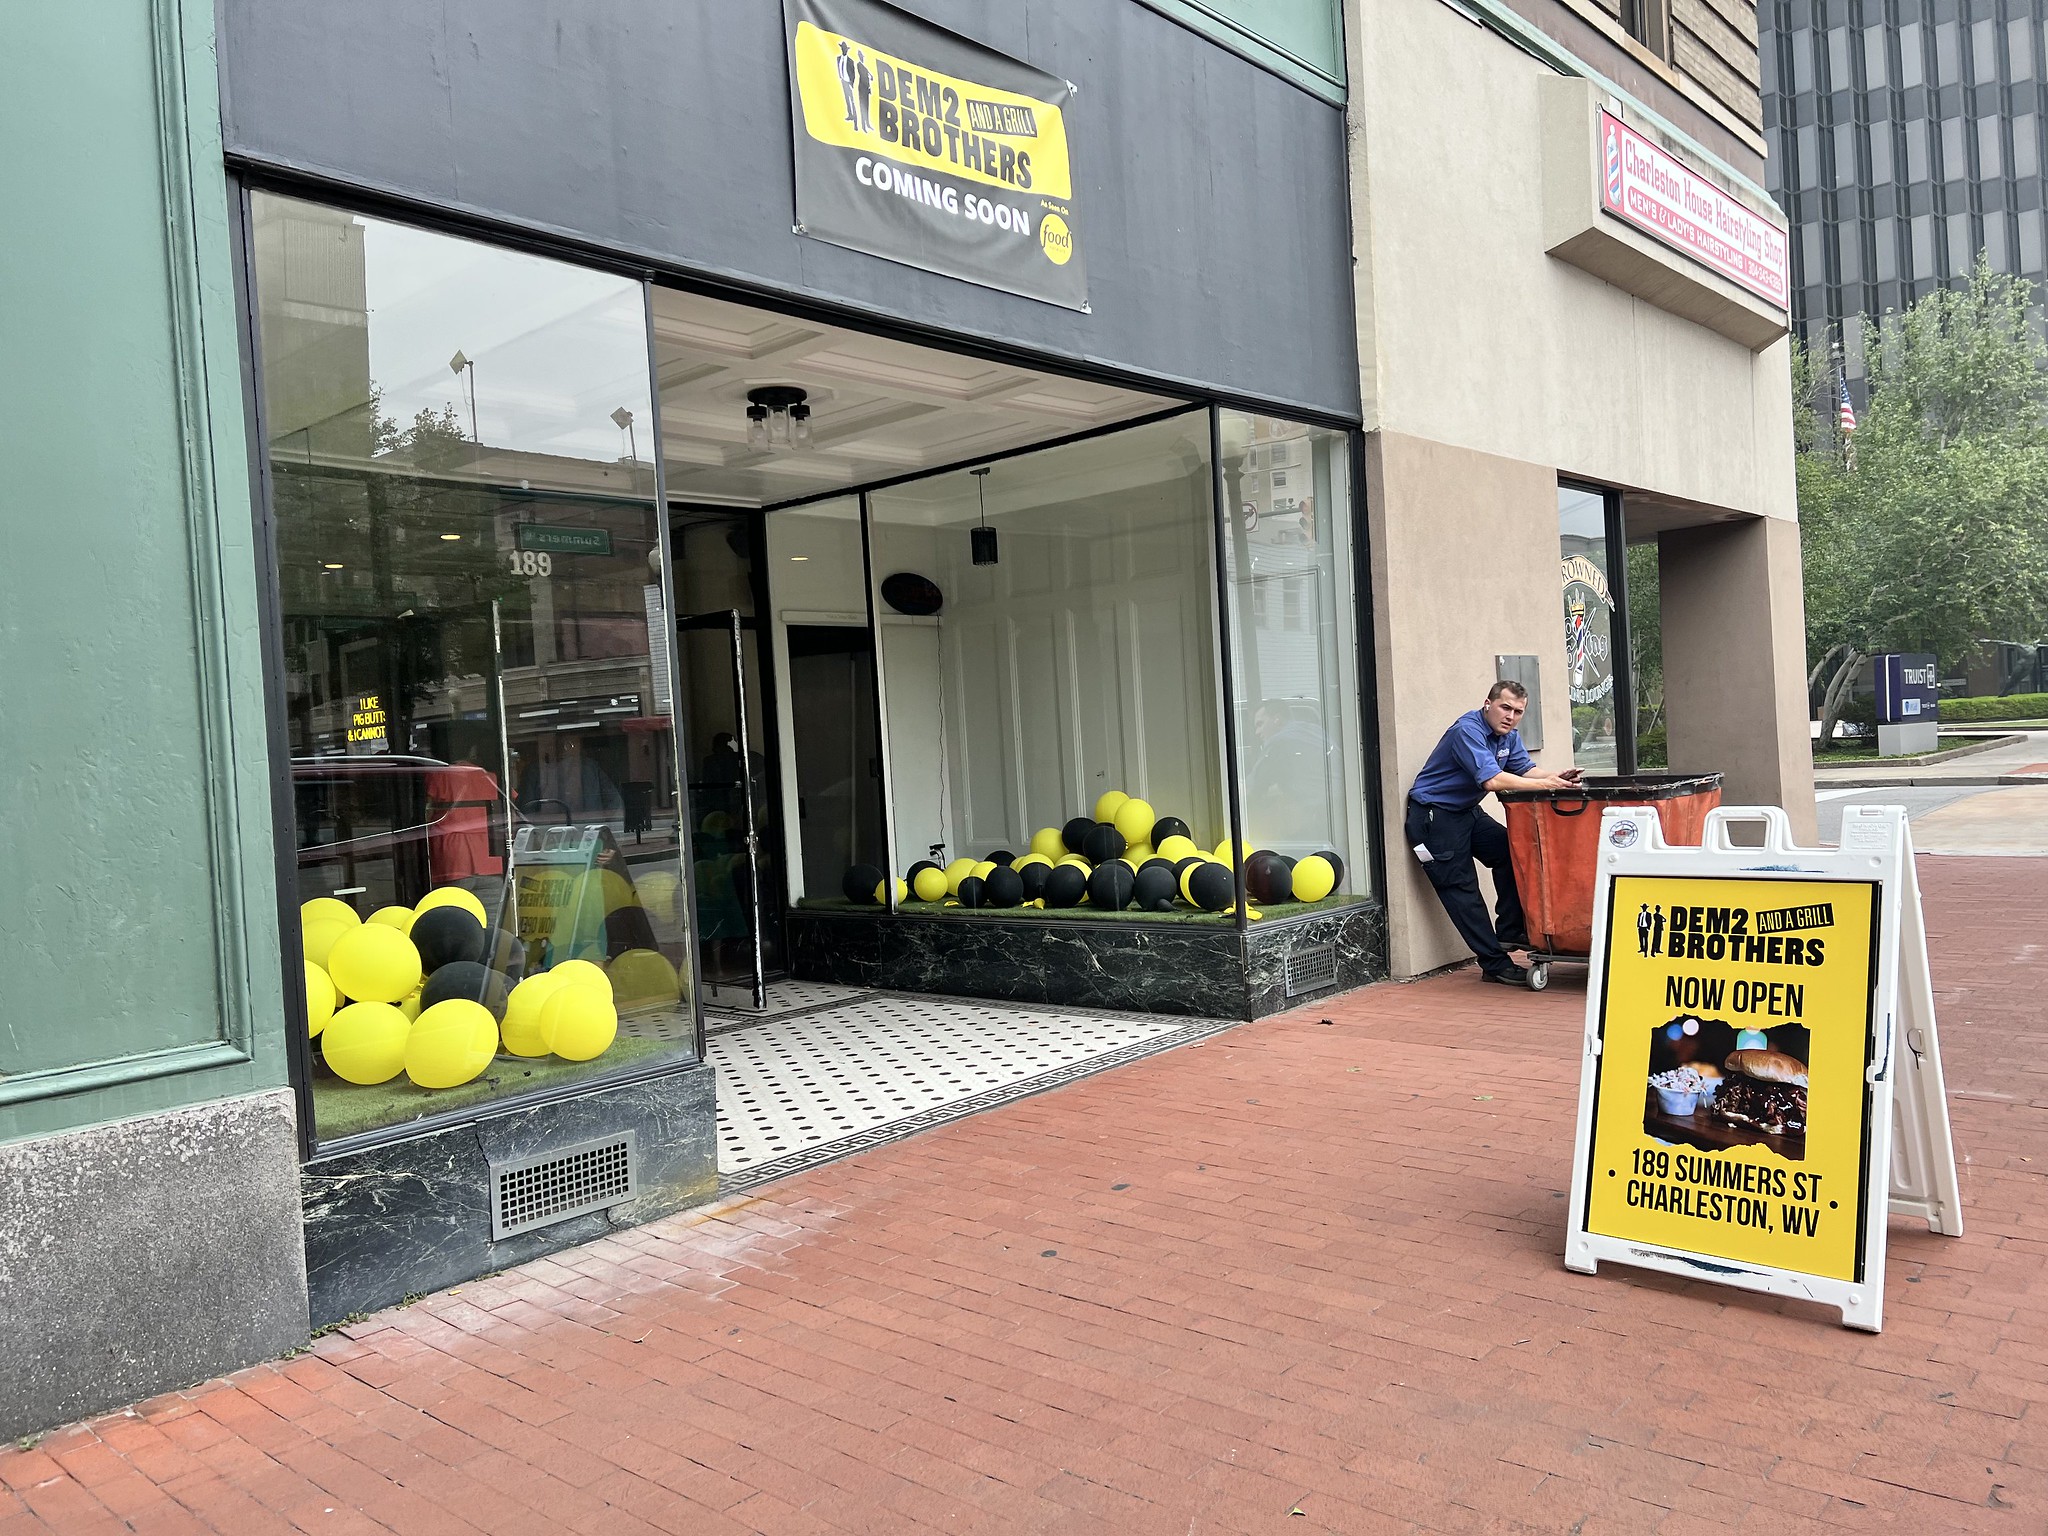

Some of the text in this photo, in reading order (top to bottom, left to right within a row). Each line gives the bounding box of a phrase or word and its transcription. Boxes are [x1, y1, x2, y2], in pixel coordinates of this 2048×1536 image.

[876, 58, 961, 128] DEM2
[969, 102, 1036, 135] AND A GRILL
[879, 99, 1032, 189] BROTHERS
[855, 156, 1031, 236] COMING SOON
[1625, 138, 1783, 273] Charleston House Hairstyling Shop
[1043, 224, 1069, 248] food
[1630, 189, 1657, 220] MEN'S
[1659, 206, 1667, 224] &
[1667, 212, 1695, 244] LADY'S
[1696, 229, 1743, 270] HAIRSTYLING
[509, 550, 552, 577] 189
[1561, 560, 1605, 595] ROWNED
[1903, 668, 1927, 685] TRUIST
[354, 713, 364, 726] PIG
[363, 696, 379, 710] LIKE
[348, 730, 354, 741] &
[357, 726, 386, 740] CANNOT
[1669, 905, 1749, 935] DEM2
[1759, 906, 1831, 932] AND A GRILL
[1668, 932, 1825, 967] BROTHERS
[1665, 975, 1804, 1018] NOW OPEN
[1632, 1148, 1823, 1203] 189 SUMMERS ST
[1626, 1179, 1820, 1238] CHARLESTON, WV
